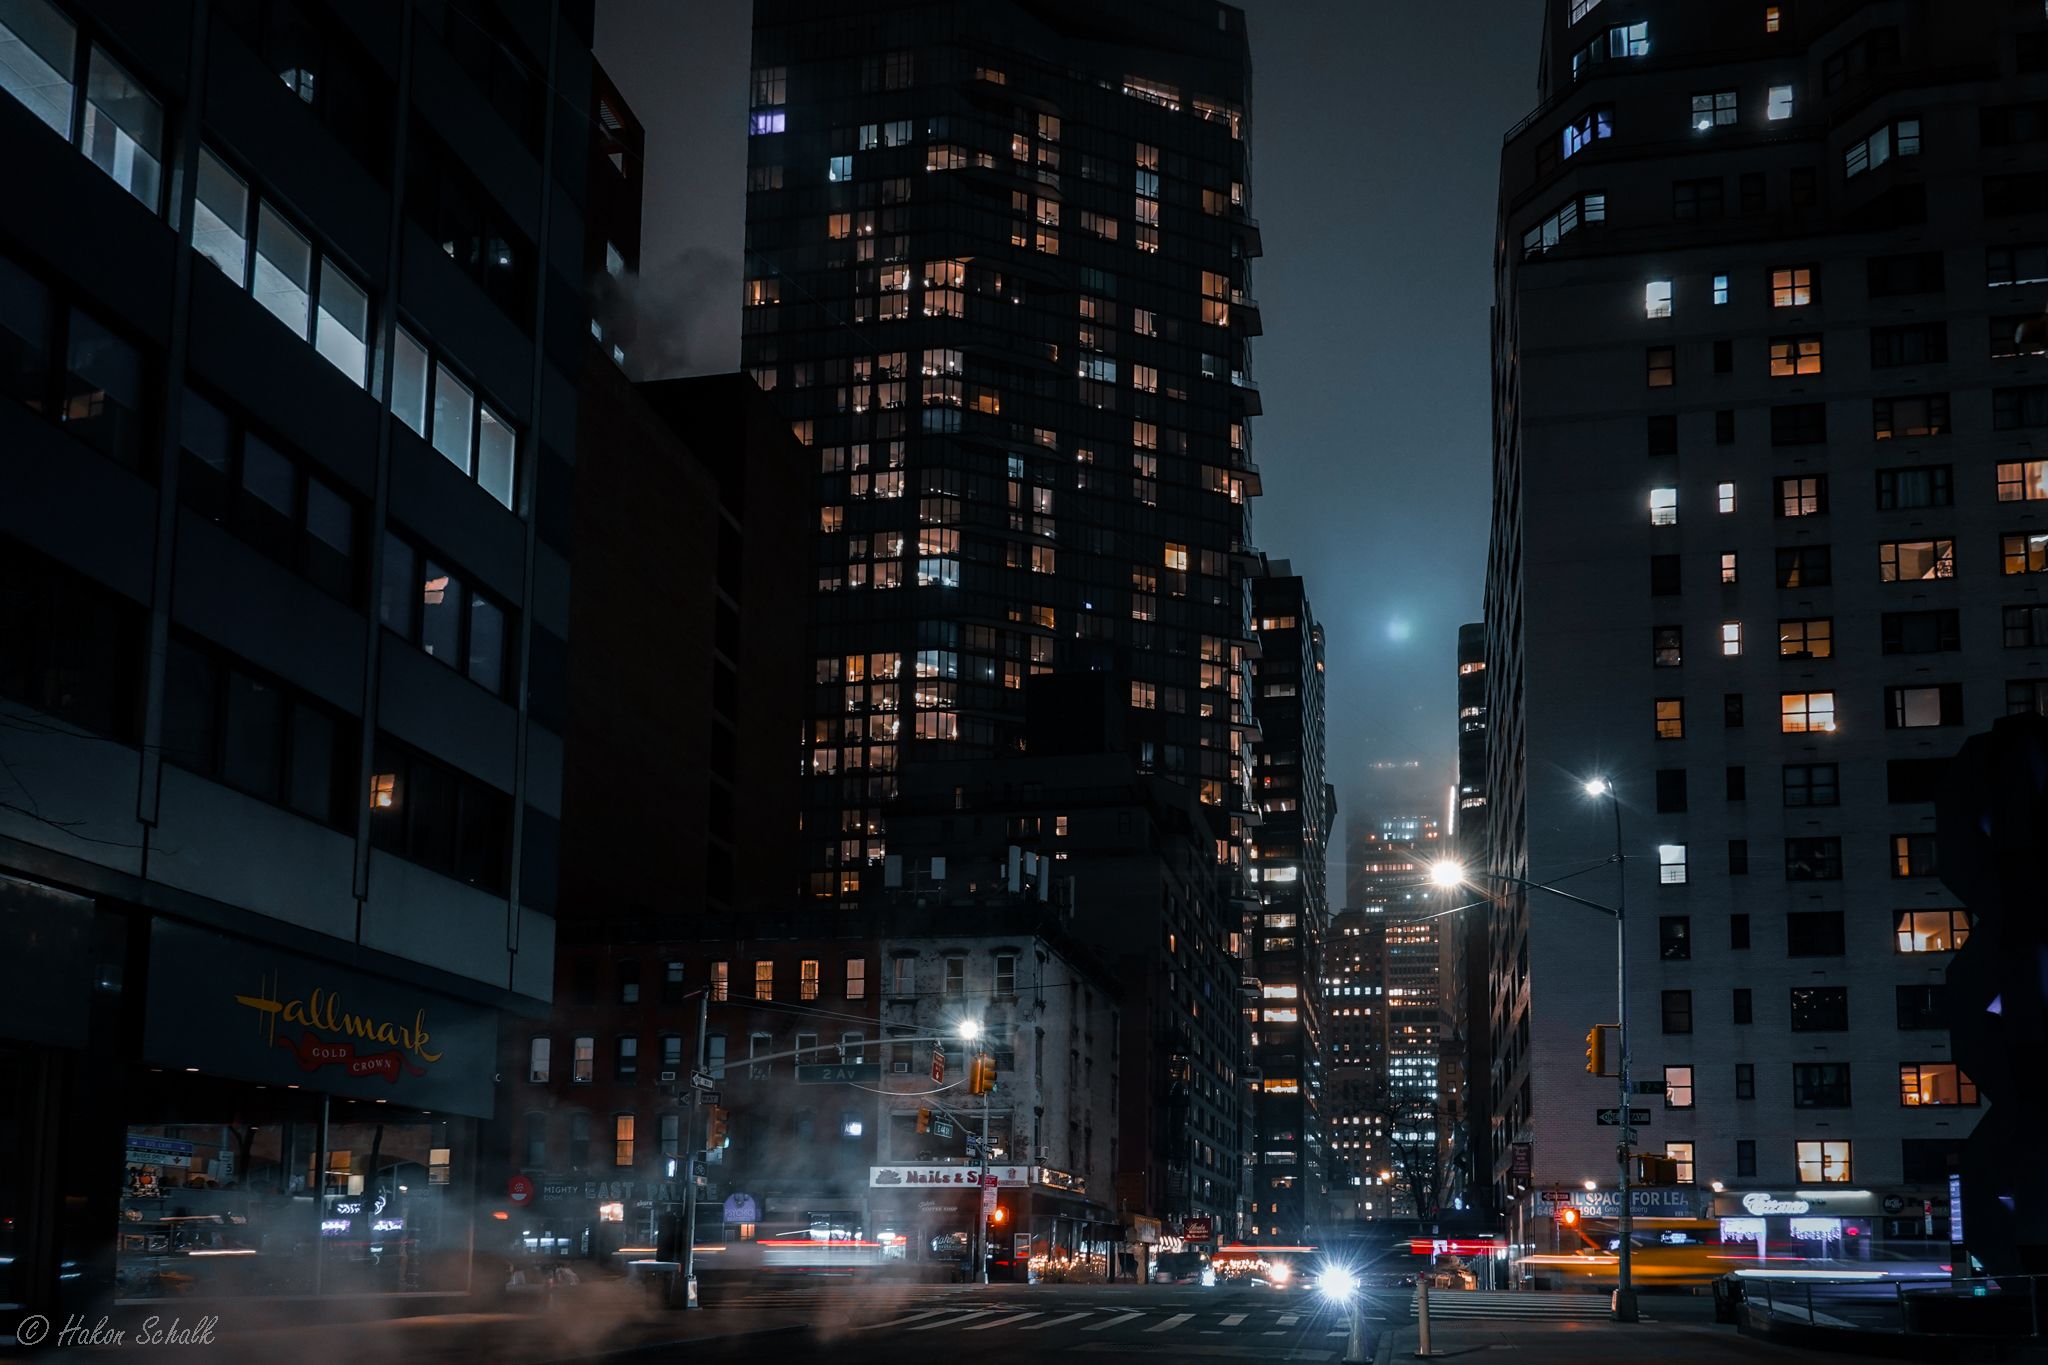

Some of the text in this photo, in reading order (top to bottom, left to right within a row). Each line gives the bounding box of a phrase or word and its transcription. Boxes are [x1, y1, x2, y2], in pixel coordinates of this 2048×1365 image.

[233, 967, 443, 1063] Hallmark
[312, 1047, 347, 1059] GOLD
[352, 1057, 393, 1073] CROWN
[822, 1069, 832, 1080] 2
[906, 1170, 951, 1184] Nails
[953, 1172, 963, 1183] &
[544, 1186, 578, 1194] MIGHTY
[585, 1181, 634, 1200] EAST
[1632, 1191, 1660, 1206] FOR
